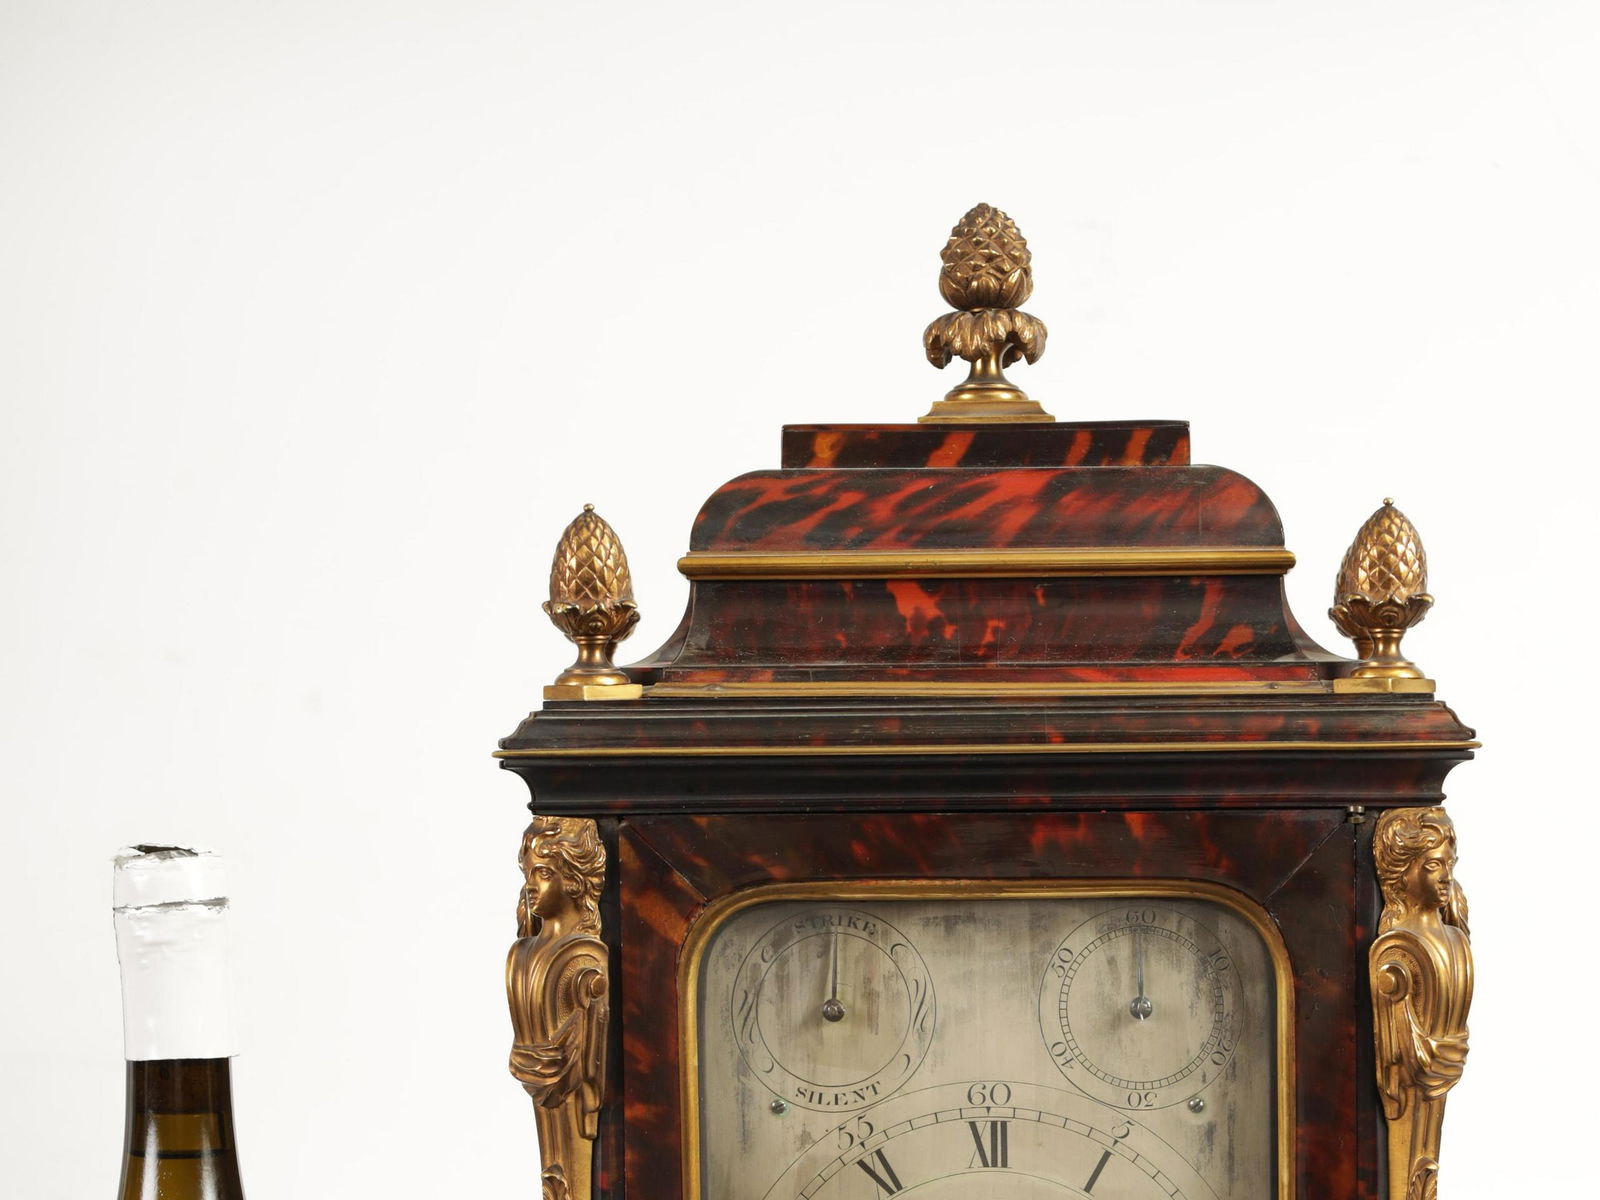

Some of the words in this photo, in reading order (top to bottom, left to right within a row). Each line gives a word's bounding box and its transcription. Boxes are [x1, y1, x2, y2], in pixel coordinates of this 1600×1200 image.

[794, 914, 877, 936] STRIKE
[1126, 909, 1157, 925] 60
[1051, 947, 1075, 979] 50
[1208, 949, 1230, 973] 10
[1050, 1041, 1075, 1072] 40
[1211, 1038, 1234, 1068] 20
[795, 1080, 882, 1106] SILENT
[966, 1083, 1012, 1106] 60
[1127, 1092, 1158, 1109] 30
[836, 1114, 875, 1150] 55
[1111, 1119, 1135, 1140] 5
[964, 1120, 1012, 1169] XII
[1083, 1149, 1117, 1197] I
